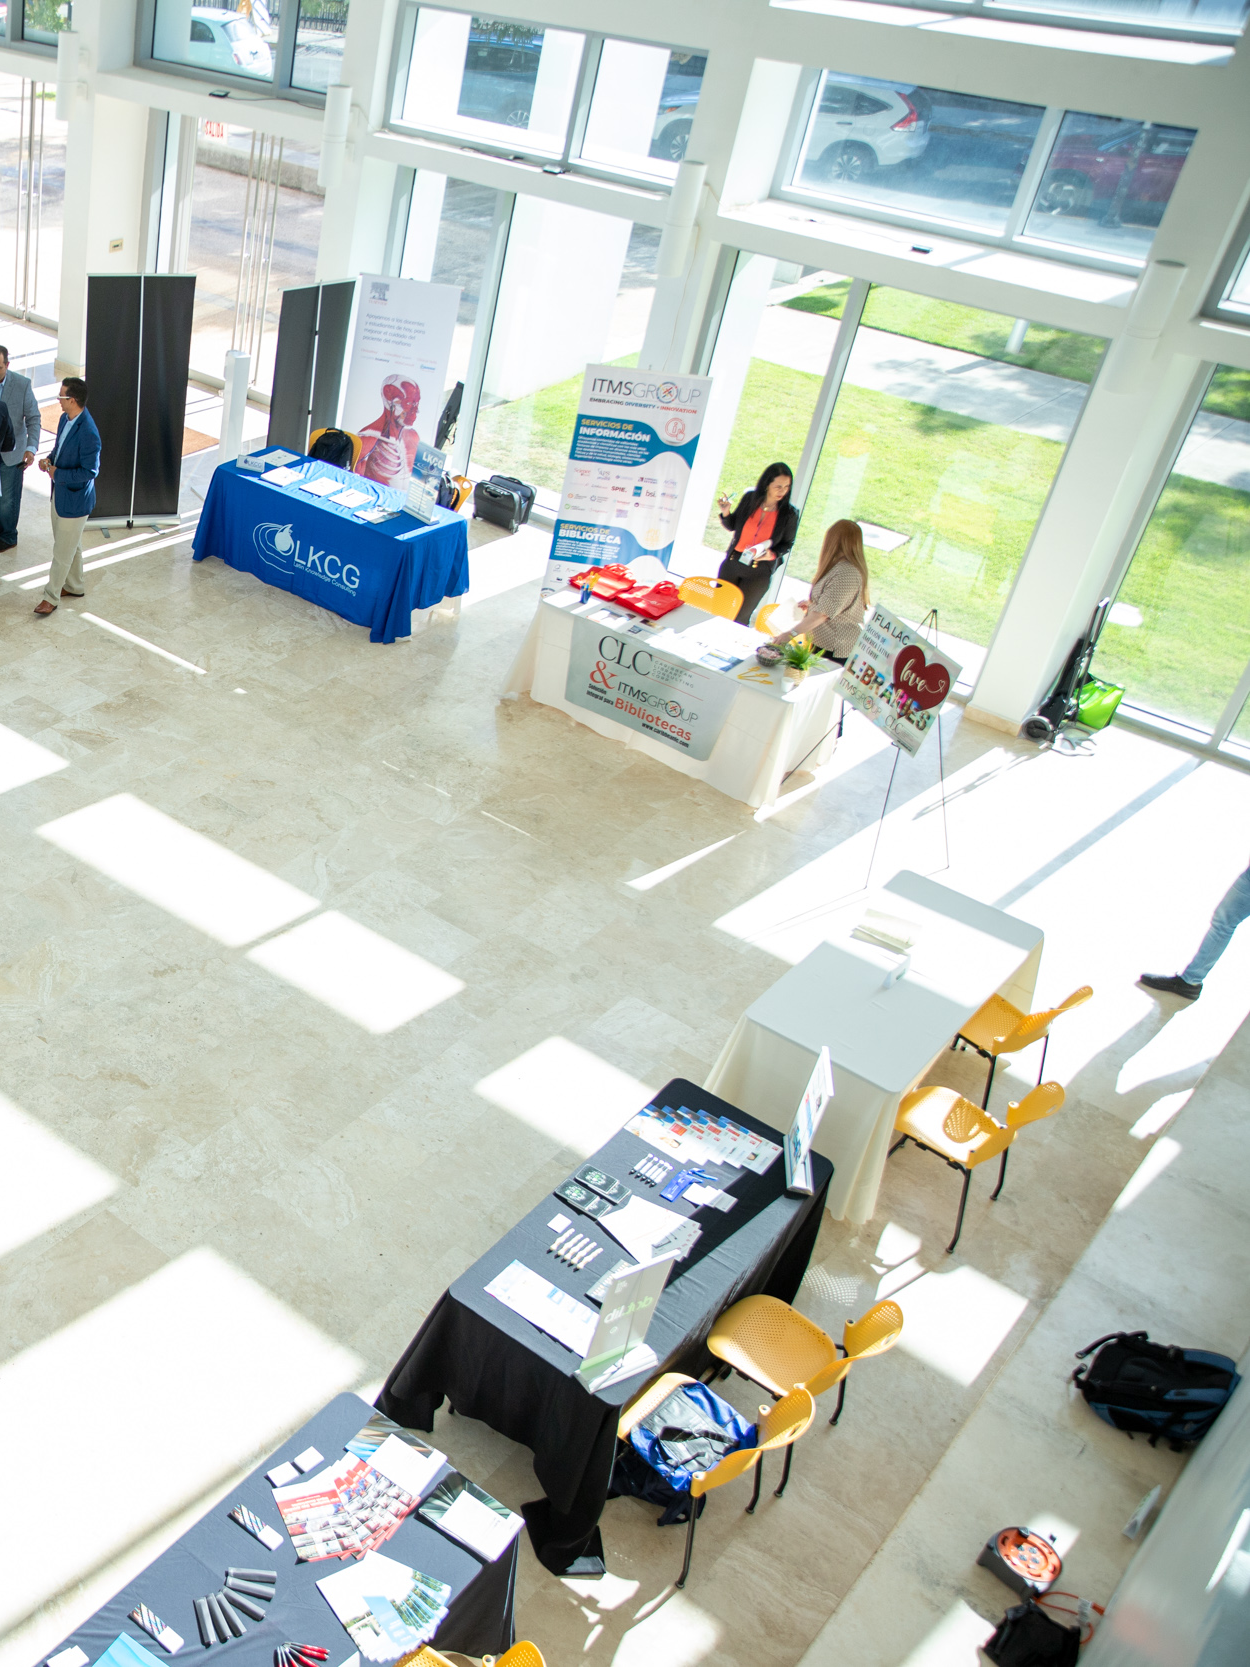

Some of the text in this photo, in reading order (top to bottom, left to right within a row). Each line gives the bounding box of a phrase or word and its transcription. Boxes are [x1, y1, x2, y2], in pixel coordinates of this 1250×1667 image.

[366, 313, 390, 322] Apoyamos
[403, 319, 425, 327] docentes
[368, 321, 395, 330] estudiantes
[363, 327, 384, 335] mejorar
[591, 377, 702, 405] ITMSGROUP
[589, 397, 625, 406] EMBRACING
[625, 401, 656, 410] DIVERSITY
[660, 405, 698, 415] INNOVATION
[581, 418, 634, 431] SERVICIOS DE
[579, 426, 651, 443] INFORMACIÓN
[558, 529, 621, 545] BIBLIOTECA
[560, 523, 599, 534] SERVICIOS
[293, 540, 361, 589] LKCG
[305, 567, 331, 583] Knowledge
[331, 578, 357, 597] Consulting
[872, 612, 910, 646] IFLA LAC
[598, 635, 654, 676] CLC
[589, 660, 618, 690] &
[652, 669, 694, 688] CONSULTING
[653, 664, 682, 678] LIBRARY
[655, 660, 693, 679] CARIBBEAN
[900, 658, 929, 692] love
[588, 683, 607, 695] Solución
[839, 677, 882, 715] ITMSGROUP
[603, 697, 614, 706] para
[617, 681, 699, 723] ITMSGROUP
[614, 697, 692, 741] Bibliotecas
[884, 714, 904, 734] CLC
